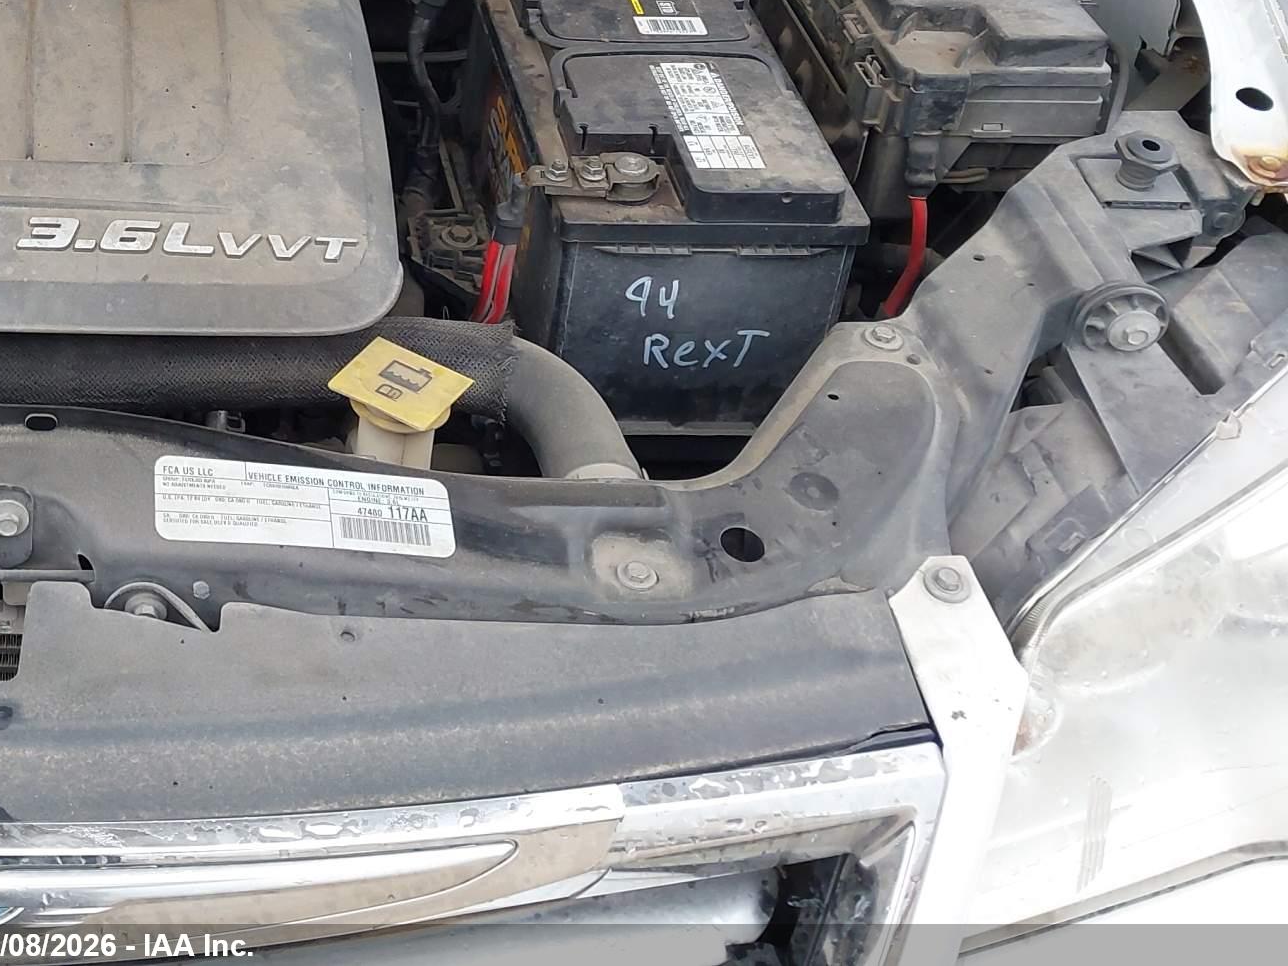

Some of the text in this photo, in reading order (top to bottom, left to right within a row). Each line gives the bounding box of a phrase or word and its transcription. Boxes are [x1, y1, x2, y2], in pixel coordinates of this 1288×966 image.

[163, 466, 214, 476] FCA US LLC
[248, 472, 425, 496] VEHICLE EMISSION CONTROL INFORMATION
[388, 506, 428, 522] 117AA
